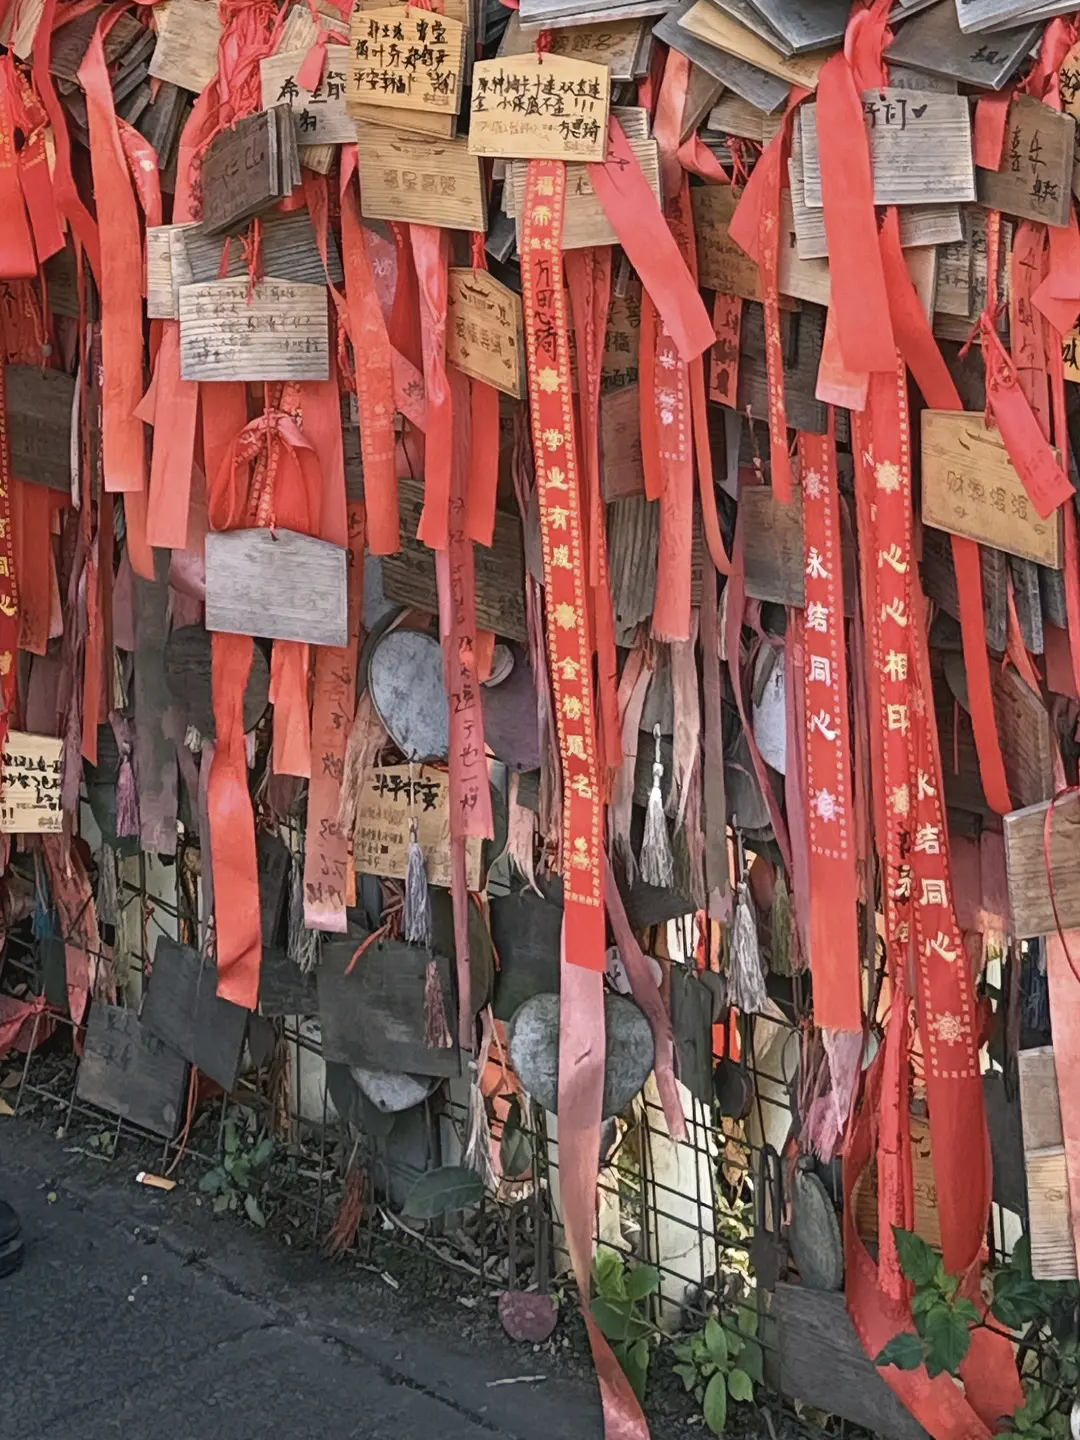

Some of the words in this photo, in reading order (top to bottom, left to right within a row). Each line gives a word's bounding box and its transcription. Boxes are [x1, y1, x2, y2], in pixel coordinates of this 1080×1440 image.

[540, 427, 576, 571] 学业有成
[556, 655, 593, 801] 金榜题名
[805, 546, 840, 742] 永结同心
[877, 543, 910, 737] 心心相印
[914, 768, 958, 962] 永结同心
